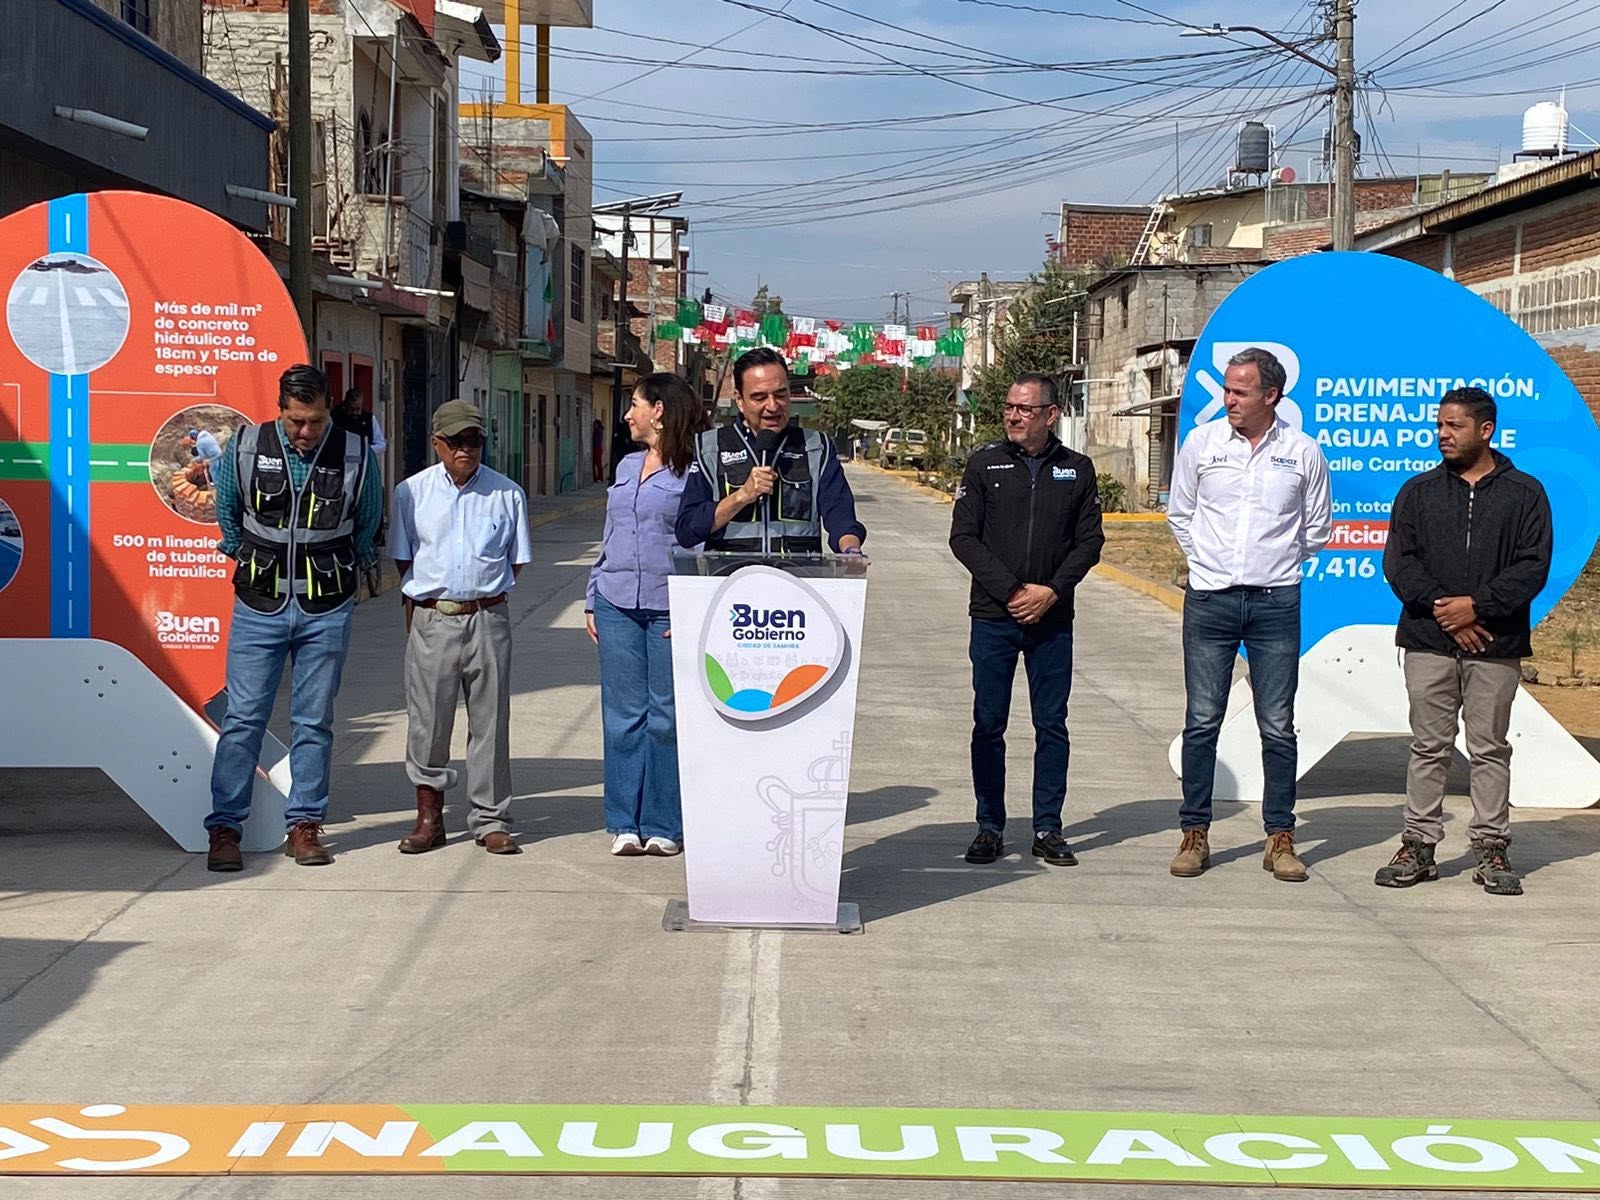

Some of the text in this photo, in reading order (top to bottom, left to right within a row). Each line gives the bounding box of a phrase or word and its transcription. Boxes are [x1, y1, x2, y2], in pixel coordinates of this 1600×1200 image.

[154, 301, 263, 316] Más de mil m²
[154, 318, 249, 331] de concreto
[154, 331, 255, 346] hidráulico de
[154, 347, 278, 363] 18cm y 15cm de
[154, 363, 218, 377] espesor
[1315, 403, 1440, 423] DRENAJE
[1315, 428, 1390, 448] AGUA
[1328, 456, 1444, 472] alle Cartag
[113, 535, 221, 549] 500 m lineale
[146, 550, 227, 564] de tubería
[149, 564, 227, 578] hidraúlica
[157, 610, 220, 633] Buen
[732, 603, 806, 628] Buen
[157, 631, 220, 643] Gobierno
[732, 627, 806, 641] Gobierno
[227, 1121, 1600, 1174] INAUGURACIÓN
